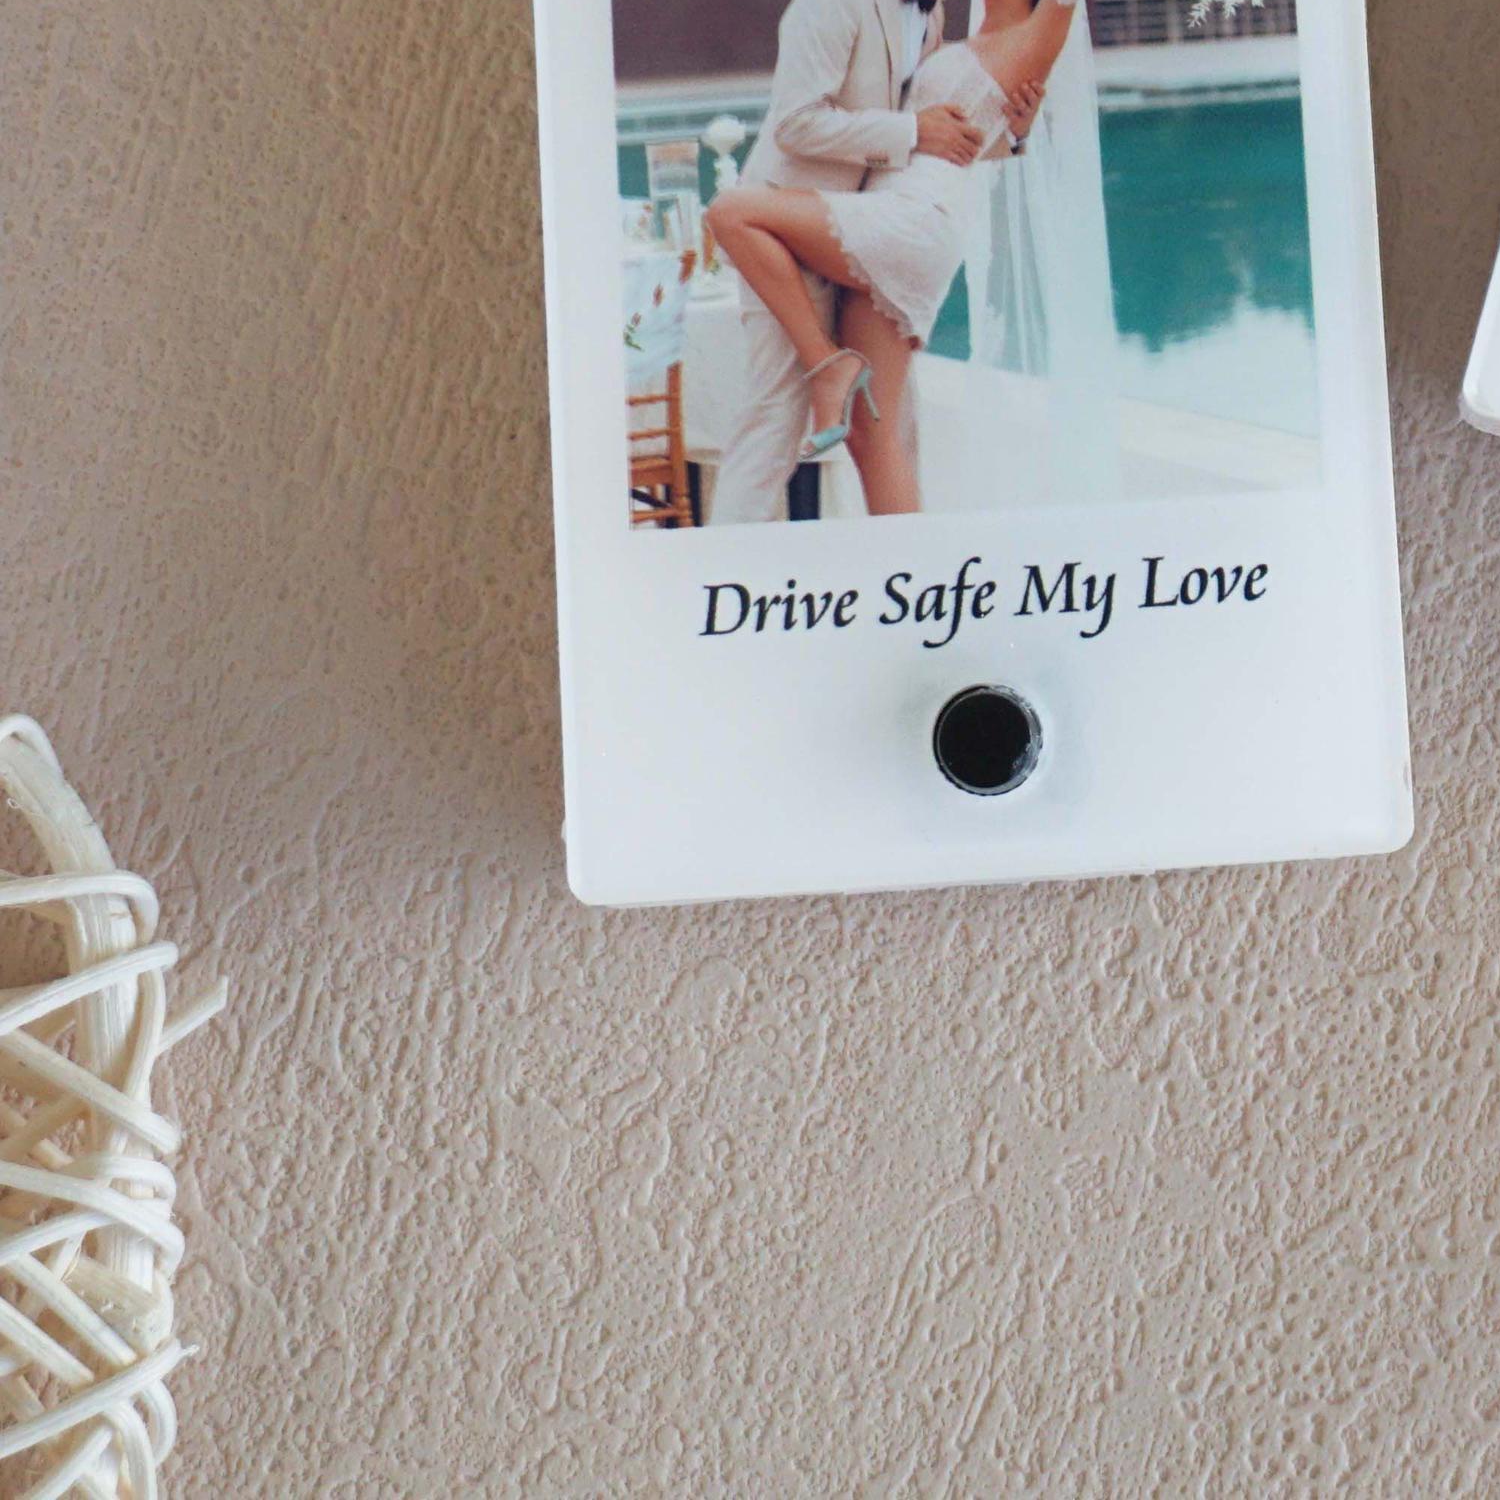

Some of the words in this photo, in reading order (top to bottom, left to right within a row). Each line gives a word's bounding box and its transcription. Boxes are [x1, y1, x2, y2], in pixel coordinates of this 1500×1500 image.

[699, 578, 859, 636] Drive
[878, 556, 997, 649] Safe
[1013, 562, 1116, 639] My
[1138, 555, 1269, 609] Love
